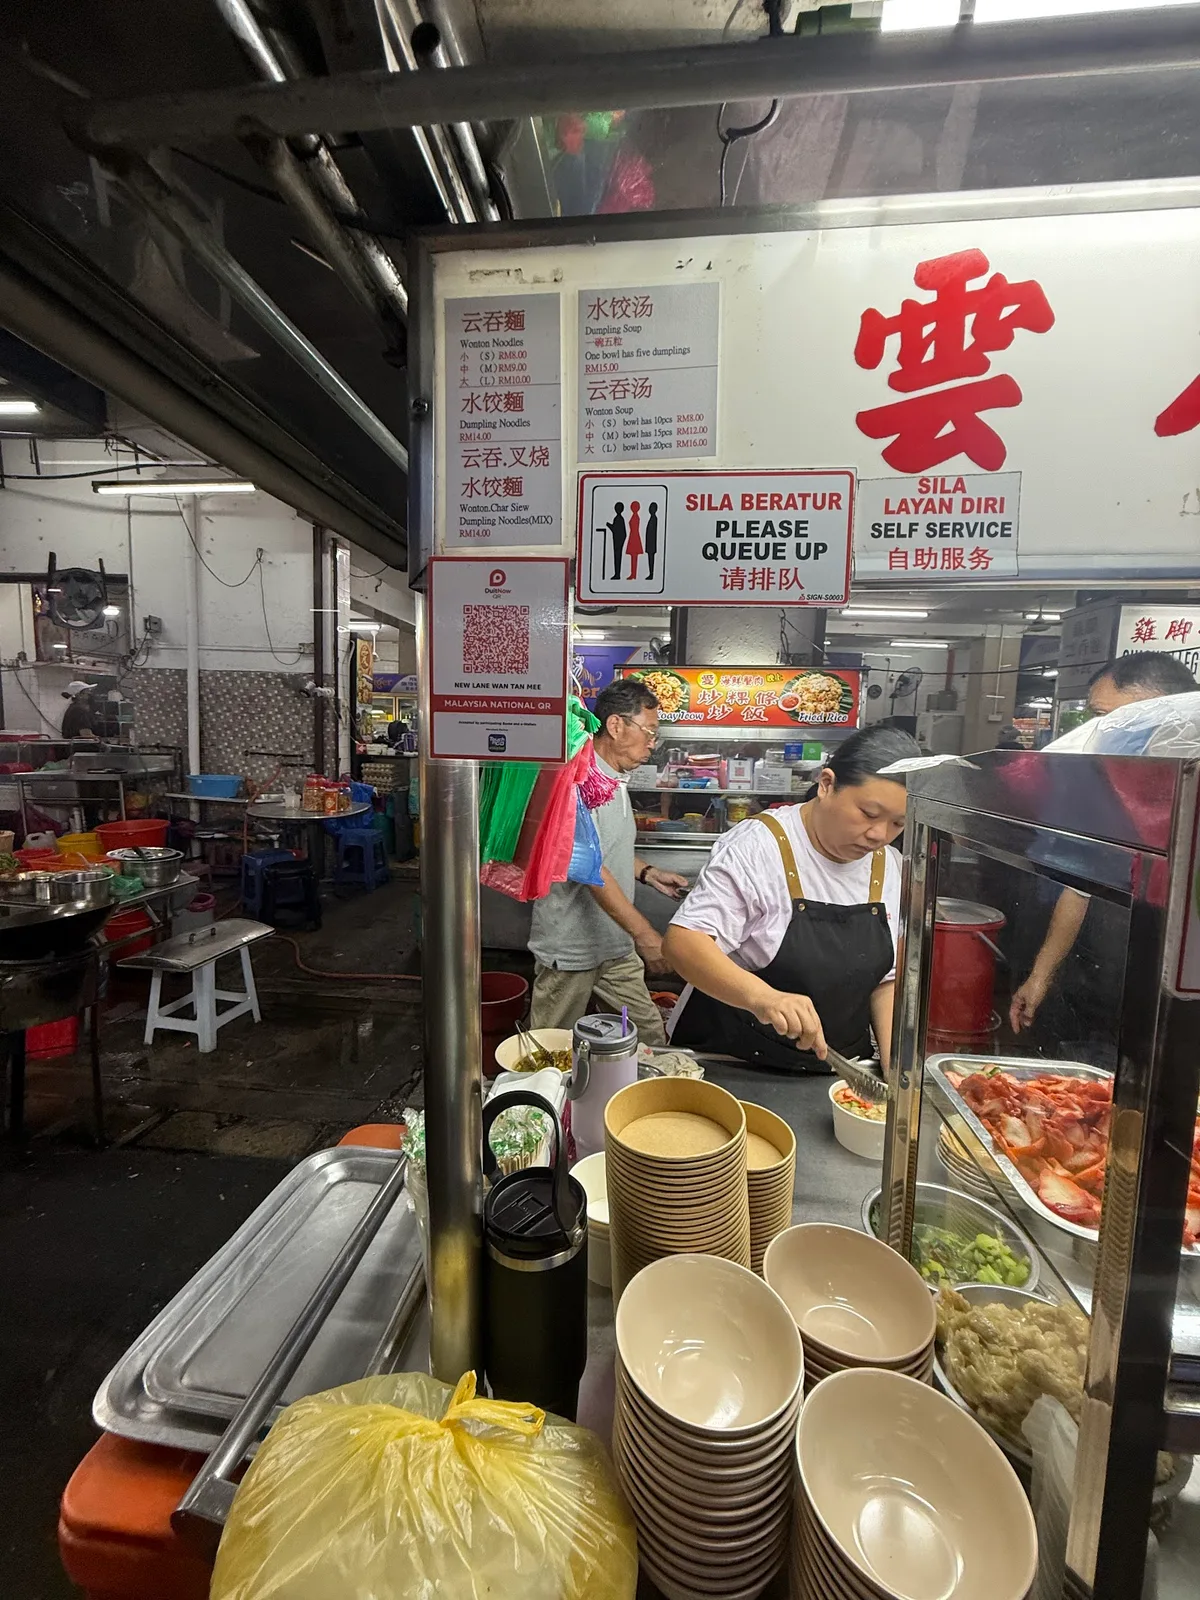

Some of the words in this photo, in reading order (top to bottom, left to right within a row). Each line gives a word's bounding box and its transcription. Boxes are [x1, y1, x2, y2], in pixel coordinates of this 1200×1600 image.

[587, 295, 654, 321] 水饺汤
[461, 309, 526, 333] 云吞麵
[585, 325, 621, 336] Dumpling
[623, 324, 642, 333] Soup
[460, 339, 490, 349] Wonton
[492, 337, 524, 347] Noodles
[460, 352, 469, 362] 小
[498, 350, 527, 360] RM8.00
[585, 351, 600, 360] One
[602, 350, 620, 360] bowl
[622, 349, 634, 358] has
[636, 348, 651, 358] five
[652, 345, 691, 357] dumplings
[854, 247, 1056, 474] 雲
[460, 364, 469, 374] 中
[498, 363, 527, 373] RM9.00
[585, 362, 619, 373] RM15.00
[460, 376, 469, 387] 大
[498, 375, 531, 385] RM10.00
[587, 377, 653, 401] 云吞汤
[461, 390, 525, 414] 水饺麵
[585, 406, 613, 416] Wonton
[615, 405, 634, 415] Soup
[460, 420, 497, 430] Dumpling
[499, 418, 531, 428] Noodles
[585, 420, 595, 429] 小
[623, 417, 639, 426] bowl
[640, 417, 652, 425] has
[654, 416, 673, 425] 10pcs
[676, 413, 704, 423] RM8.00
[459, 432, 491, 441] RM14.00
[585, 431, 594, 441] 中
[623, 430, 639, 439] bowl
[640, 429, 652, 438] has
[654, 428, 673, 438] 15pcs
[676, 426, 708, 436] RM12.00
[585, 444, 594, 454] 大
[623, 442, 639, 451] bowl
[640, 442, 652, 450] has
[653, 441, 673, 450] 20pcs
[676, 438, 708, 448] RM16.00
[461, 476, 524, 499] 水饺麵
[918, 477, 967, 494] SILA
[511, 502, 530, 512] Siew
[685, 493, 734, 511] SILA
[740, 492, 842, 511] BERATUR
[884, 497, 953, 515] LAYAN
[961, 496, 1005, 514] DIRI
[459, 516, 496, 527] Dumpling
[498, 515, 553, 525] Noodles(MIX)
[715, 520, 809, 538] PLEASE
[459, 528, 491, 538] RM14.00
[870, 522, 919, 539] SELF
[925, 521, 1012, 539] SERVICE
[702, 542, 786, 562] QUEUE
[795, 542, 828, 560] UP
[888, 546, 994, 571] 自助服务
[719, 566, 805, 591] 请排队
[444, 699, 488, 708] MALAYSIA
[490, 701, 536, 709] NATIONAL
[538, 702, 551, 710] QR
